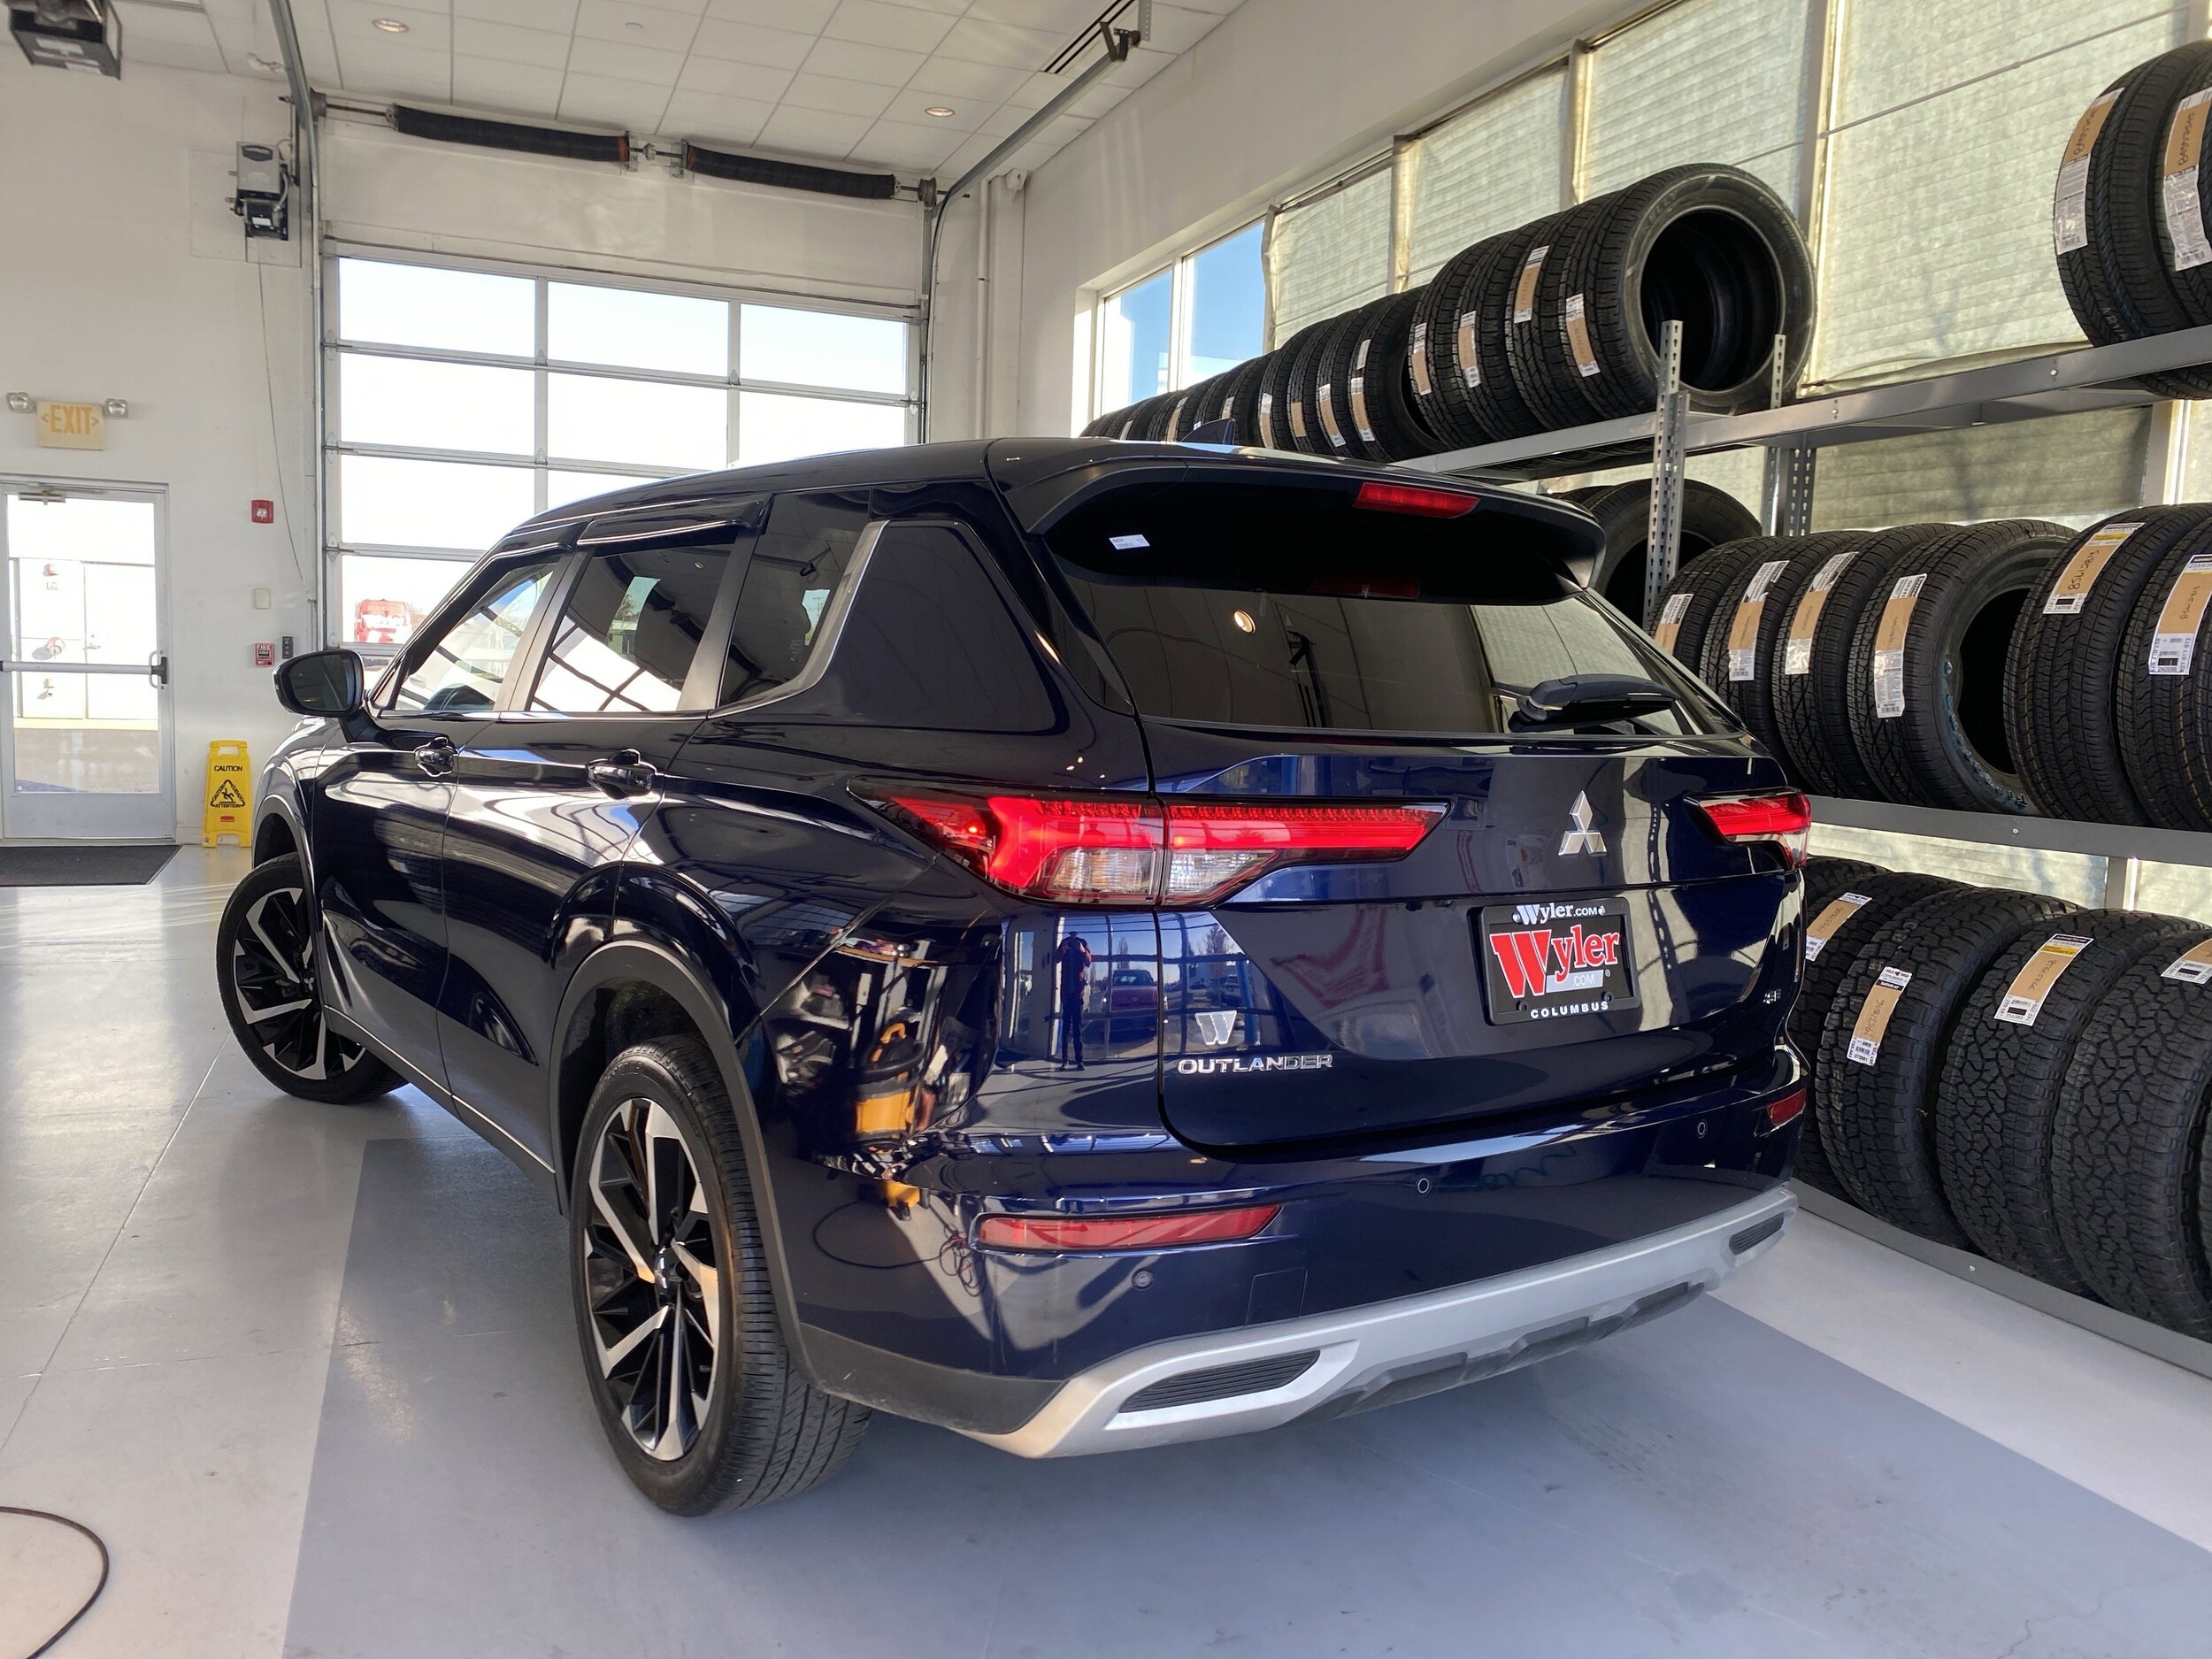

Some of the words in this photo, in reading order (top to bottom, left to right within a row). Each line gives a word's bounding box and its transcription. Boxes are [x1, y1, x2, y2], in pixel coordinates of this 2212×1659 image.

[50, 404, 92, 435] EXIT
[1489, 924, 1620, 999] Wyler
[1530, 1001, 1609, 1018] COLUMBUS
[1178, 1054, 1333, 1075] OUTLANDER
